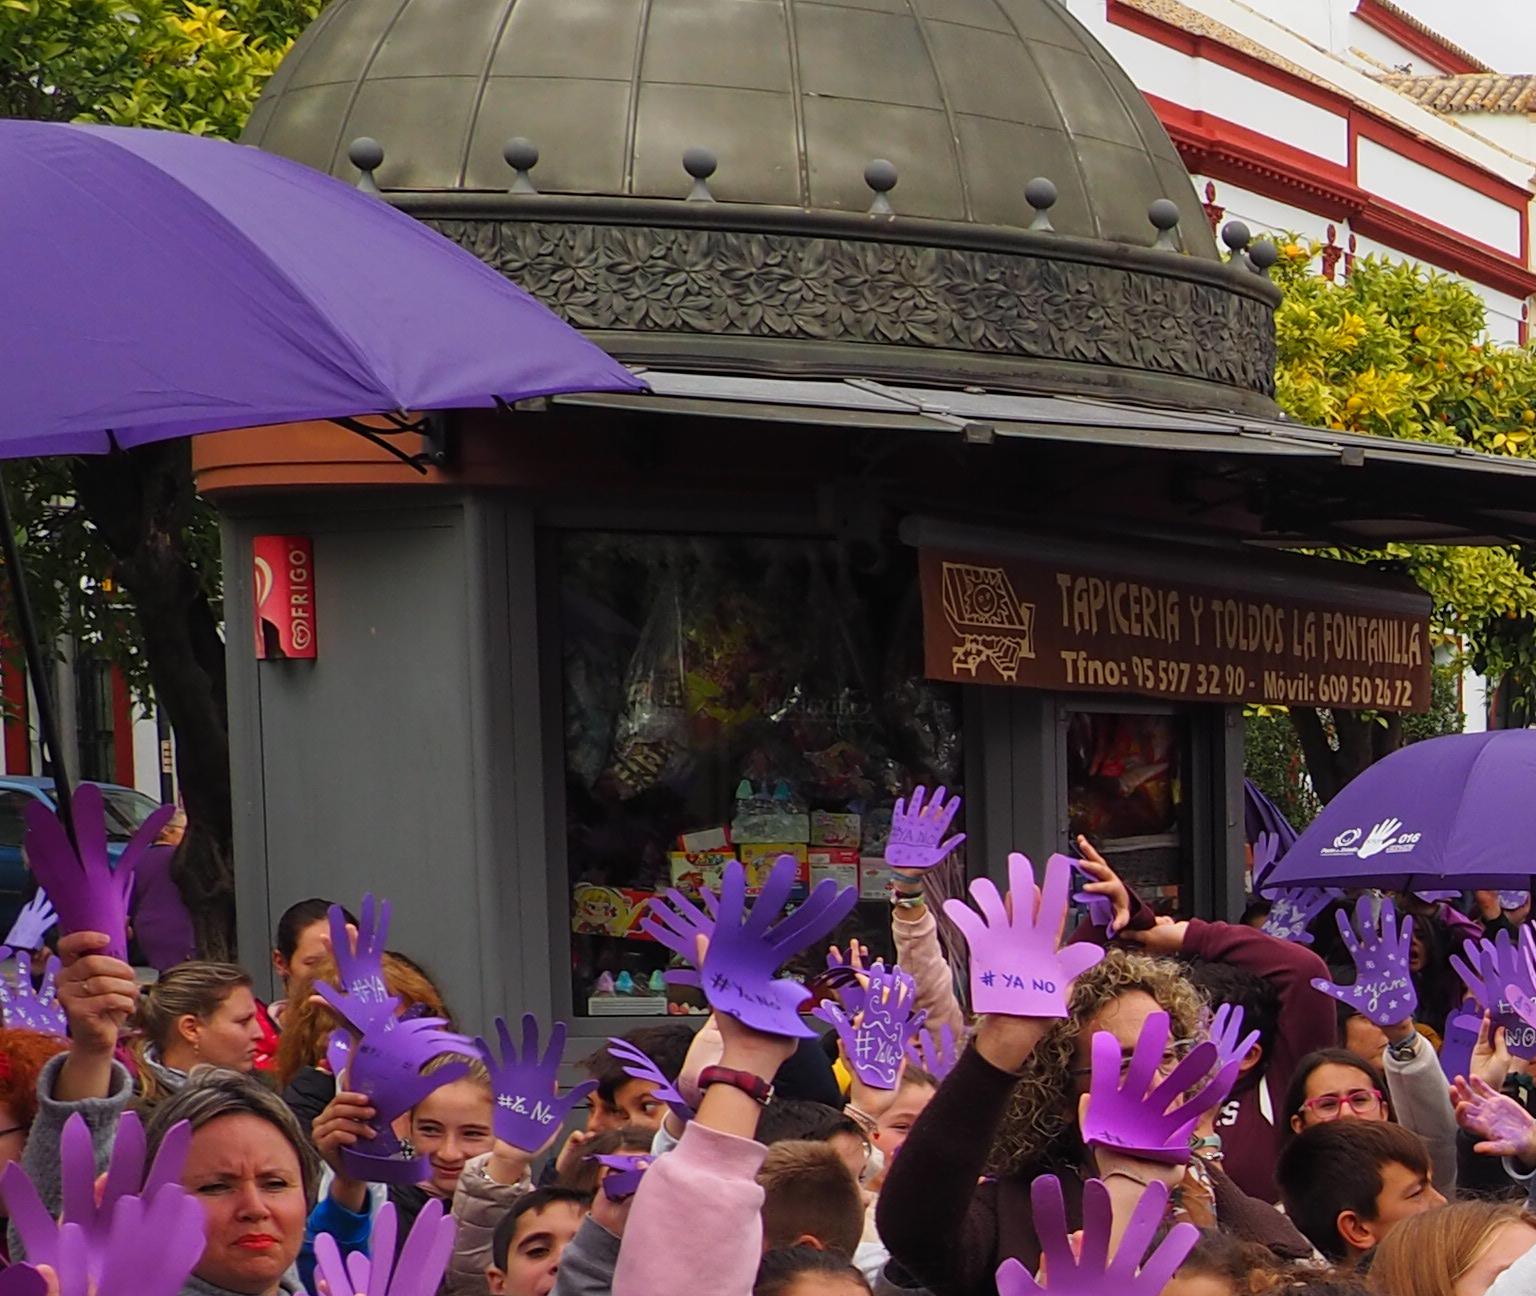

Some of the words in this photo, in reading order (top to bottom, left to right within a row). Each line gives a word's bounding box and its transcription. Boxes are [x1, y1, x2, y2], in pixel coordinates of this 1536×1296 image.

[290, 548, 308, 617] FRIGO
[1056, 573, 1180, 643] TAPICERIA
[1190, 597, 1203, 646] Y
[1212, 600, 1285, 655] TOLDOS
[1292, 610, 1316, 659] LA
[1323, 612, 1423, 667] FONTANILLA
[1060, 649, 1129, 686] Tfno:
[1133, 656, 1155, 690] 95
[1157, 659, 1190, 693] 597
[1196, 663, 1221, 696] 32
[1224, 665, 1245, 697] 90
[1264, 669, 1315, 702] Móvil:
[1318, 676, 1348, 704] 609
[1351, 677, 1372, 705] 50
[1374, 679, 1391, 706] 26
[1394, 679, 1413, 707] 72
[1031, 978, 1057, 994] NO
